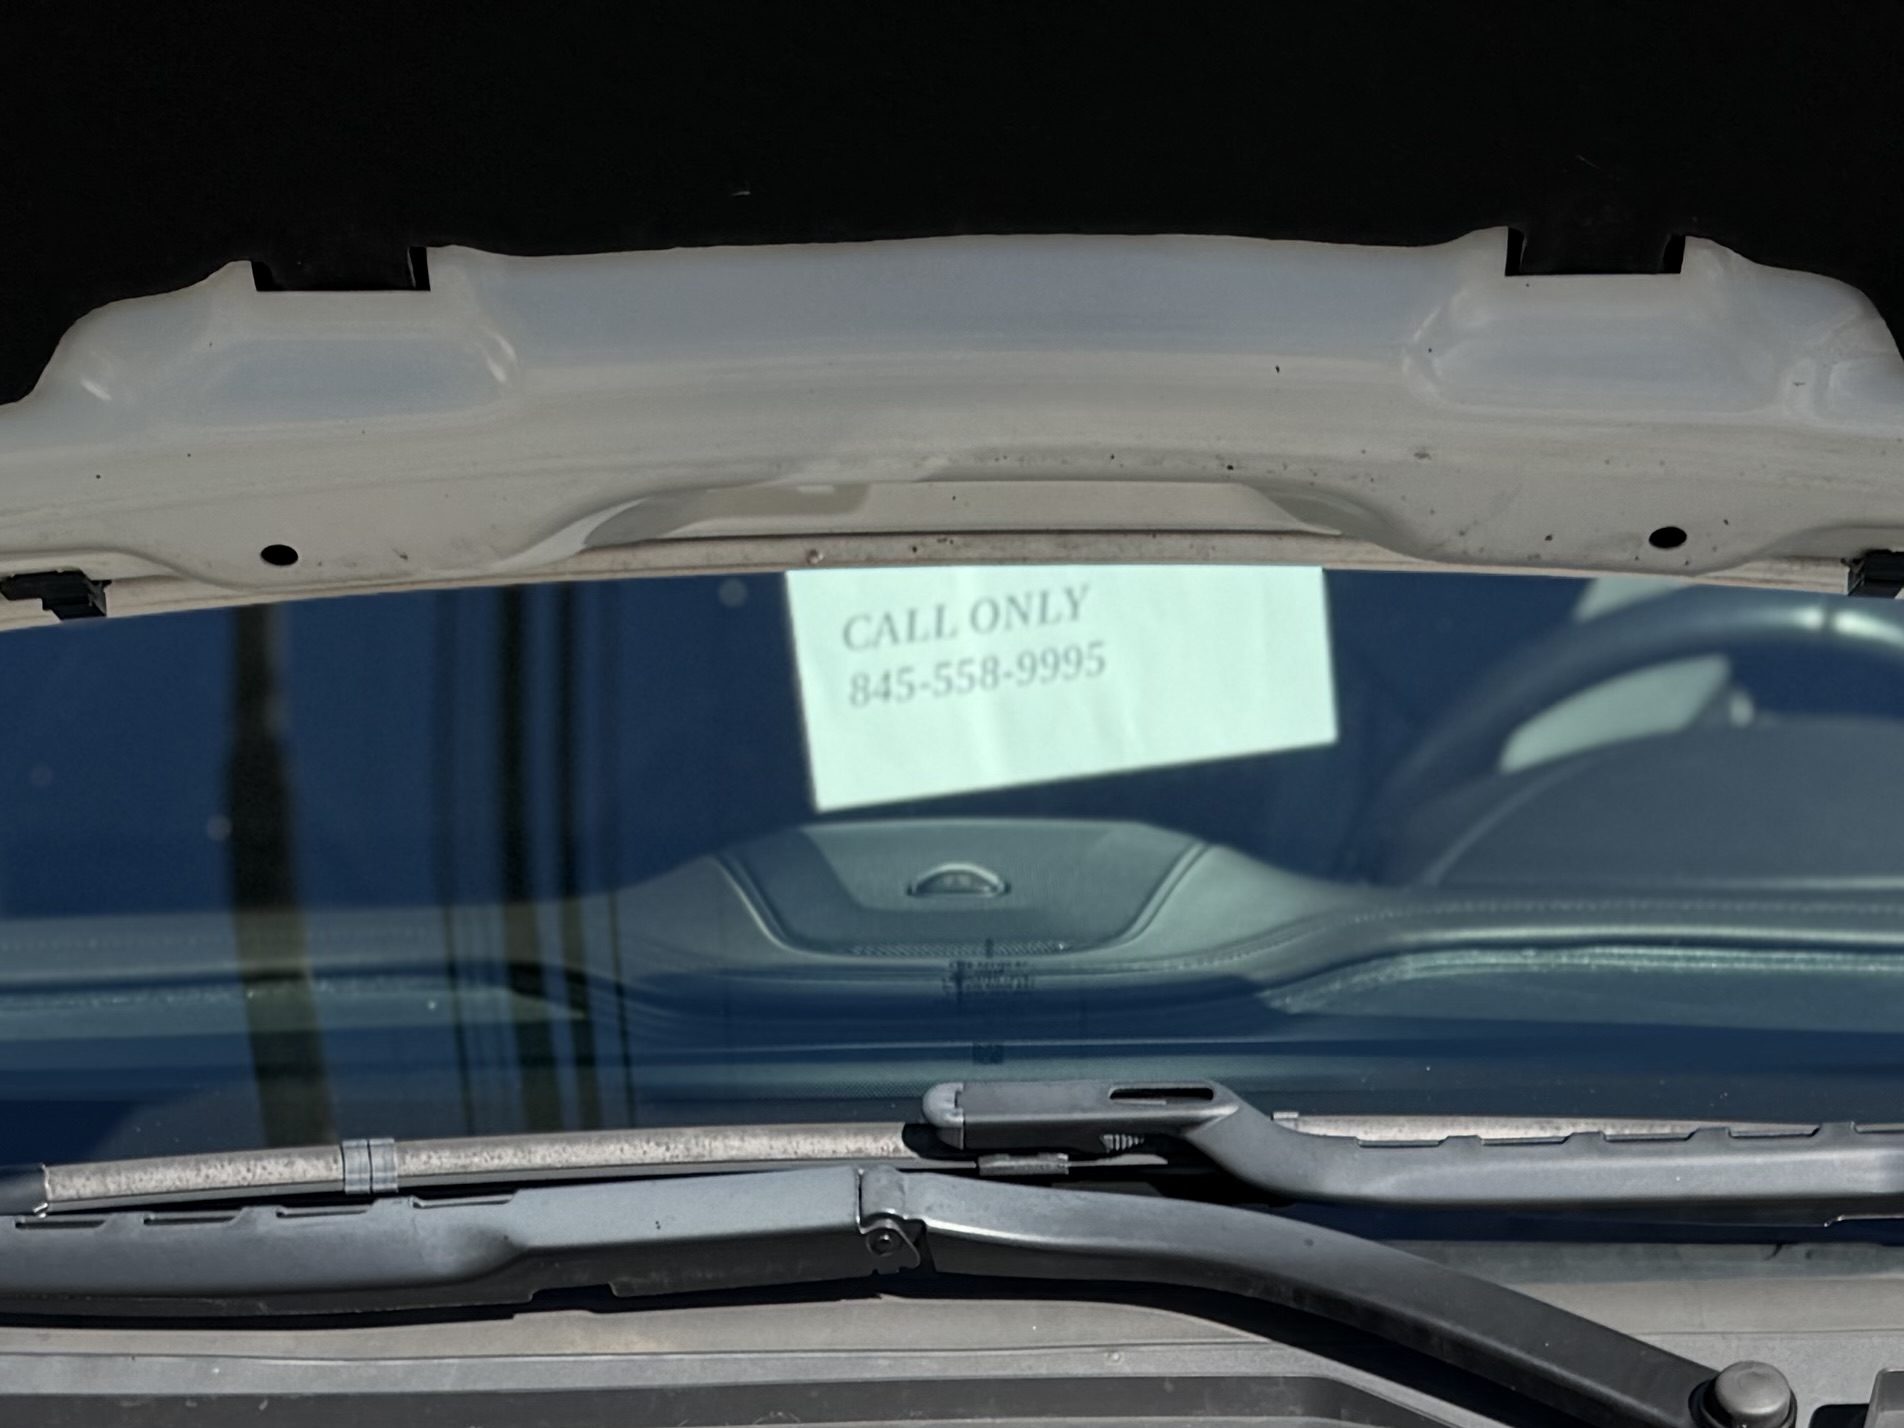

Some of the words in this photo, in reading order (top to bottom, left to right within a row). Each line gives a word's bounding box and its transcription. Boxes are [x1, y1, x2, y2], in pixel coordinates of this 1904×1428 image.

[841, 602, 960, 651] CALL
[969, 584, 1092, 635] ONLY
[848, 641, 1107, 708] 845-558-9995
